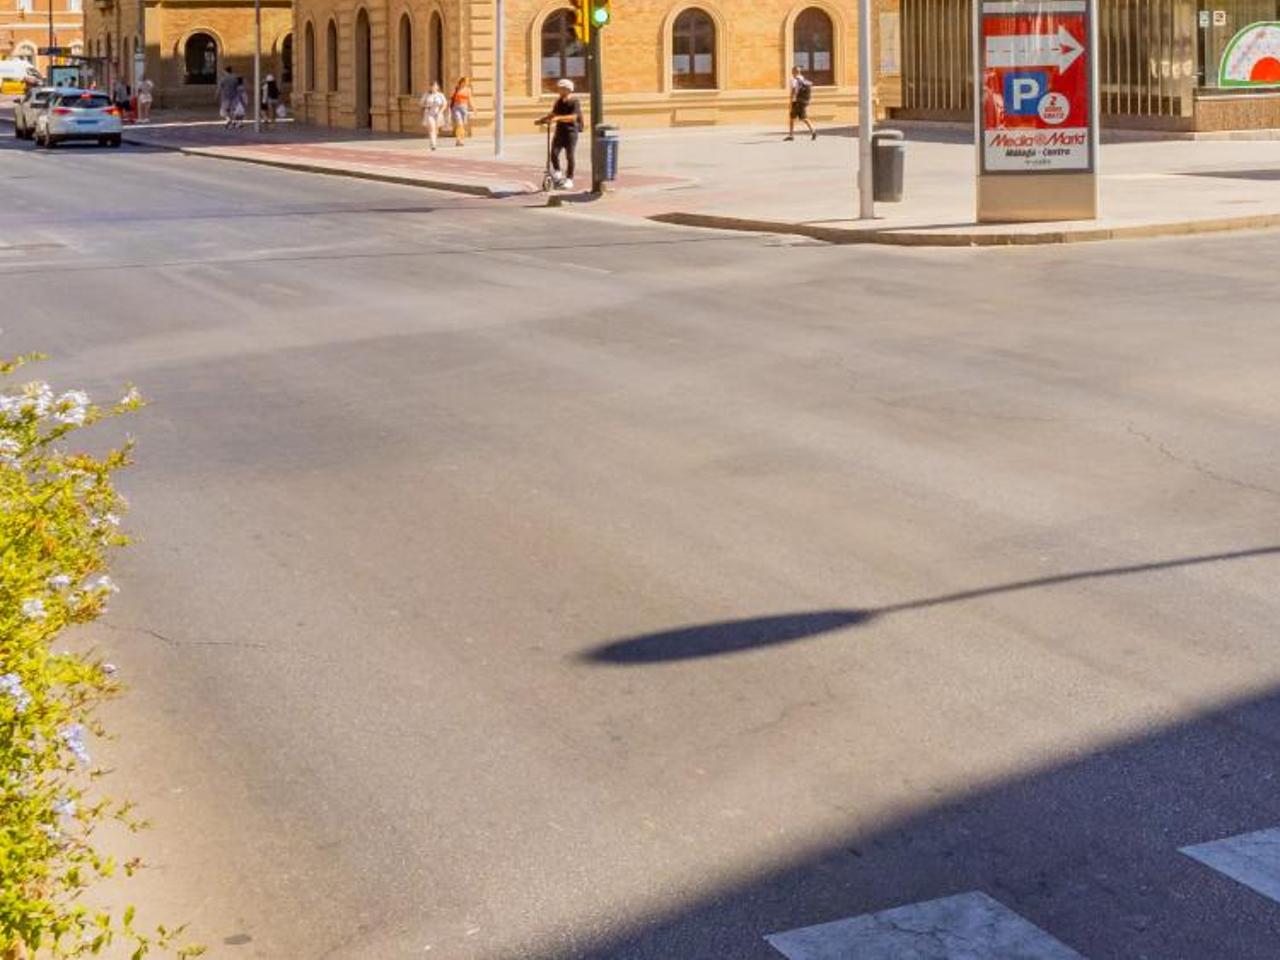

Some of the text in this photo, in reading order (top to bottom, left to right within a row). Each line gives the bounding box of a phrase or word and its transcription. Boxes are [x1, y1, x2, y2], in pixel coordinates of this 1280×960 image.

[1013, 78, 1040, 110] P
[990, 132, 1086, 147] Media Markt
